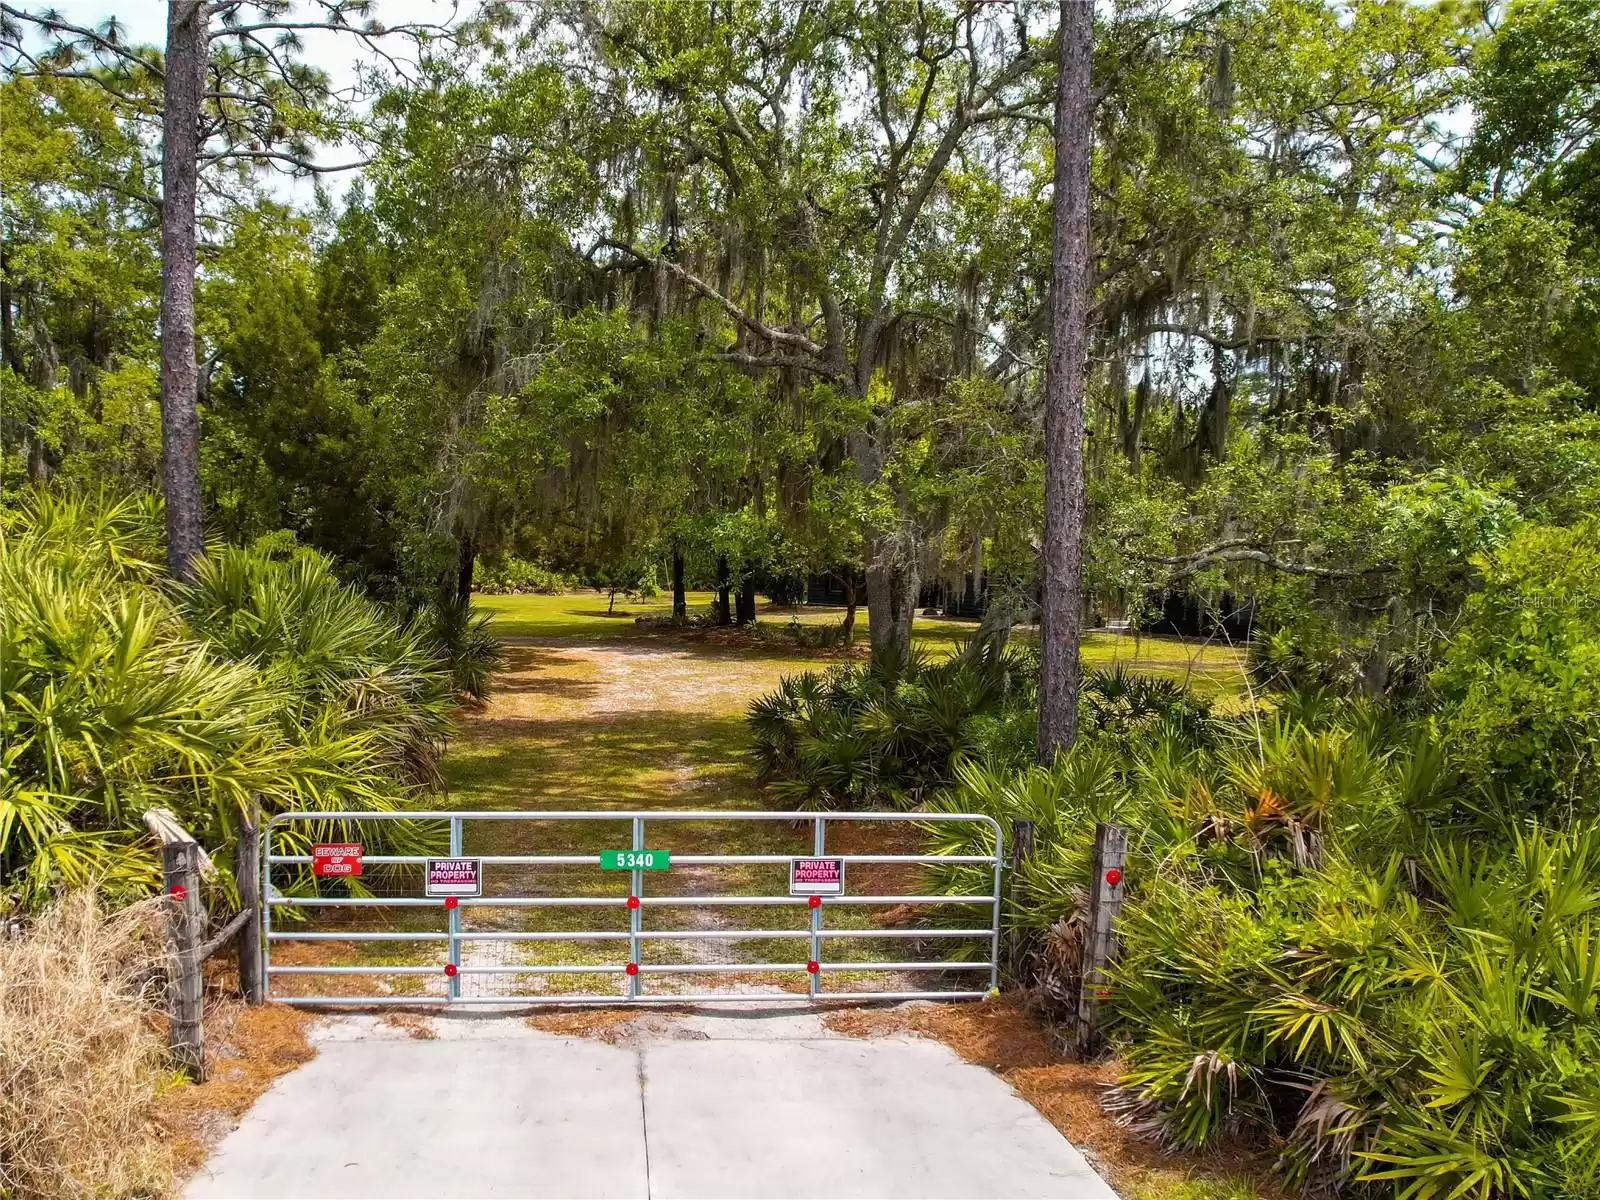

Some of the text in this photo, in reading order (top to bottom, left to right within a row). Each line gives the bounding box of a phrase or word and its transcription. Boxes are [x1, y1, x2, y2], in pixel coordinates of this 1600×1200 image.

[315, 847, 360, 857] BEWARE
[617, 853, 654, 867] 5340
[323, 863, 352, 873] DOG
[435, 862, 473, 871] PRIVATE
[799, 861, 836, 870] PRIVATE
[430, 870, 477, 880] PROPERTY
[795, 870, 840, 879] PROPERTY
